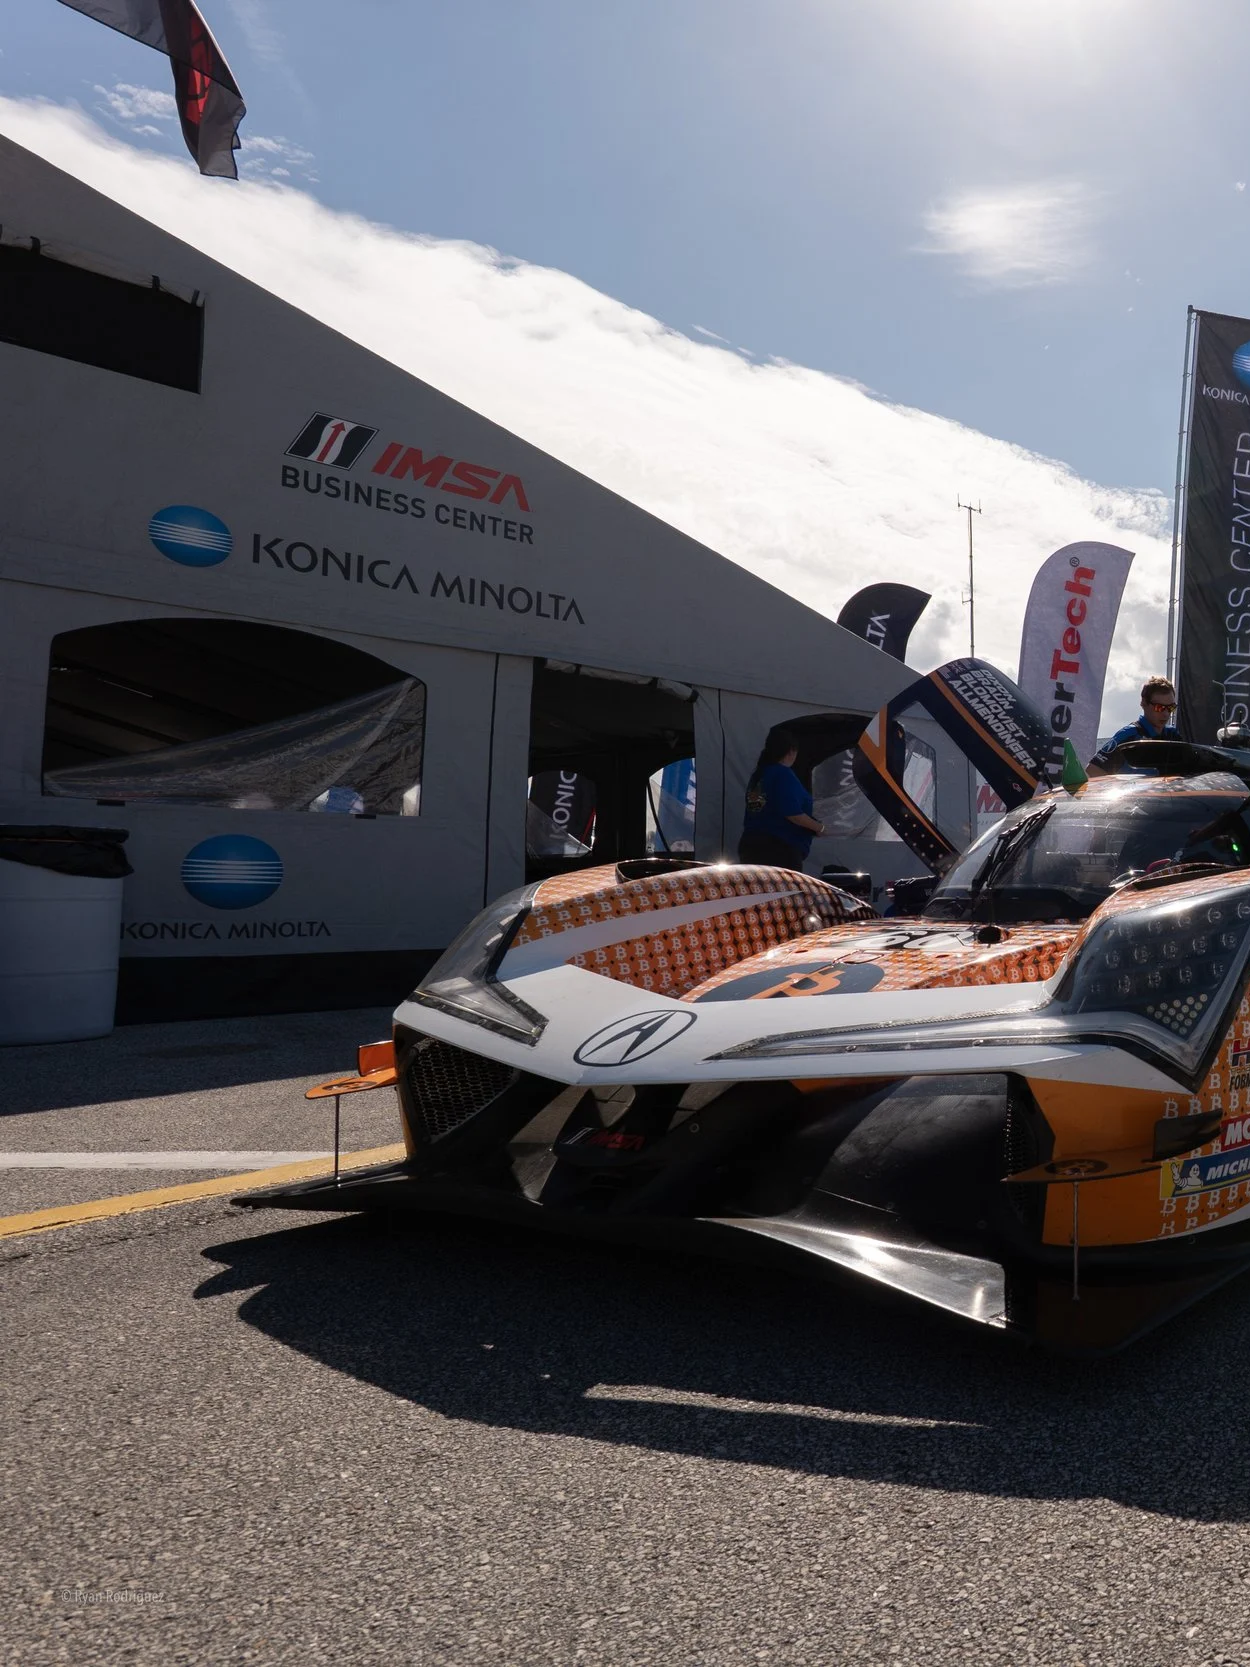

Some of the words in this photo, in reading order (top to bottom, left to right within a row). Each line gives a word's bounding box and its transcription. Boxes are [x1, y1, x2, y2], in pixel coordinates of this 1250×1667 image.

[1203, 384, 1249, 405] KONICA
[281, 465, 427, 519] BUSINESS
[434, 503, 535, 545] CENTER
[371, 442, 532, 513] IMSA
[252, 533, 420, 595] KONICA
[430, 571, 586, 626] MINOLTA
[960, 672, 1027, 740] BLOMQVIST
[970, 670, 1014, 710] BRAUN
[980, 668, 1017, 702] DIXON
[948, 680, 1037, 770] ALLMENDINGER
[120, 921, 222, 940] KONICA
[228, 920, 333, 940] MINOLTA
